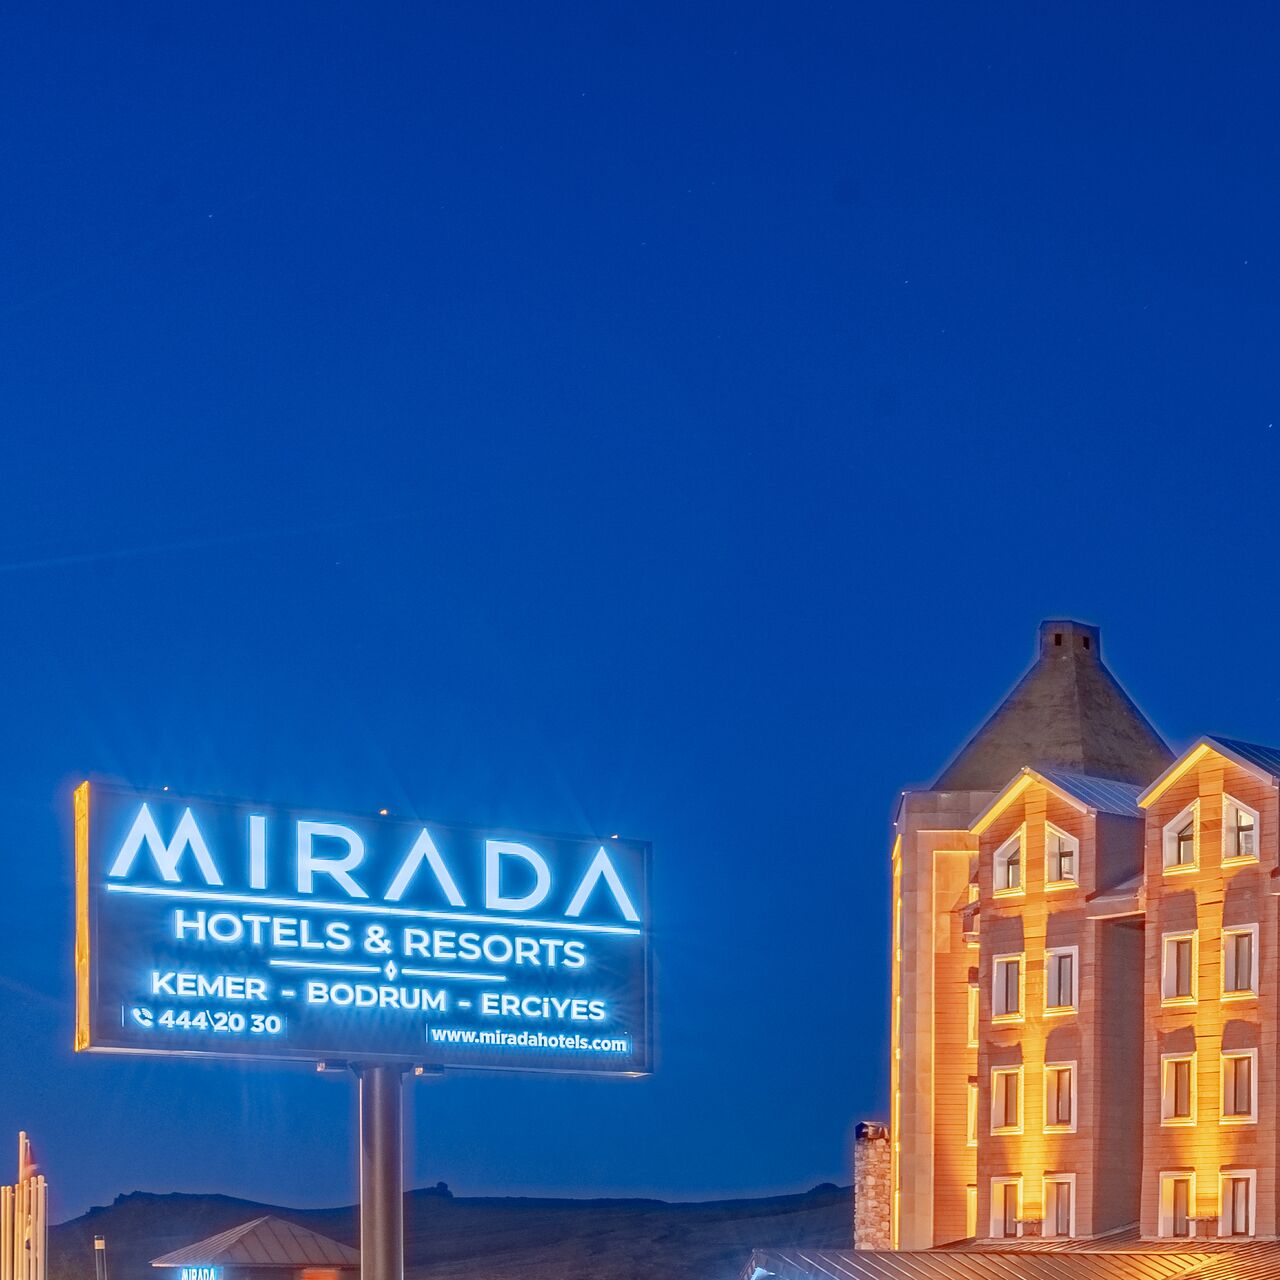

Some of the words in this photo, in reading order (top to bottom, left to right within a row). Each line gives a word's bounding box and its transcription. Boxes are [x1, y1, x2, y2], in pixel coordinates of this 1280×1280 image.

[109, 802, 640, 922] MIRADA
[174, 909, 351, 952] HOTELS
[363, 926, 392, 955] &
[403, 928, 586, 969] RESORTS
[151, 971, 267, 1001] KEMER
[307, 982, 446, 1012] BODRUM
[159, 1009, 207, 1030] 444
[250, 1015, 281, 1034] 30
[431, 1027, 628, 1053] www.miradahotels.com
